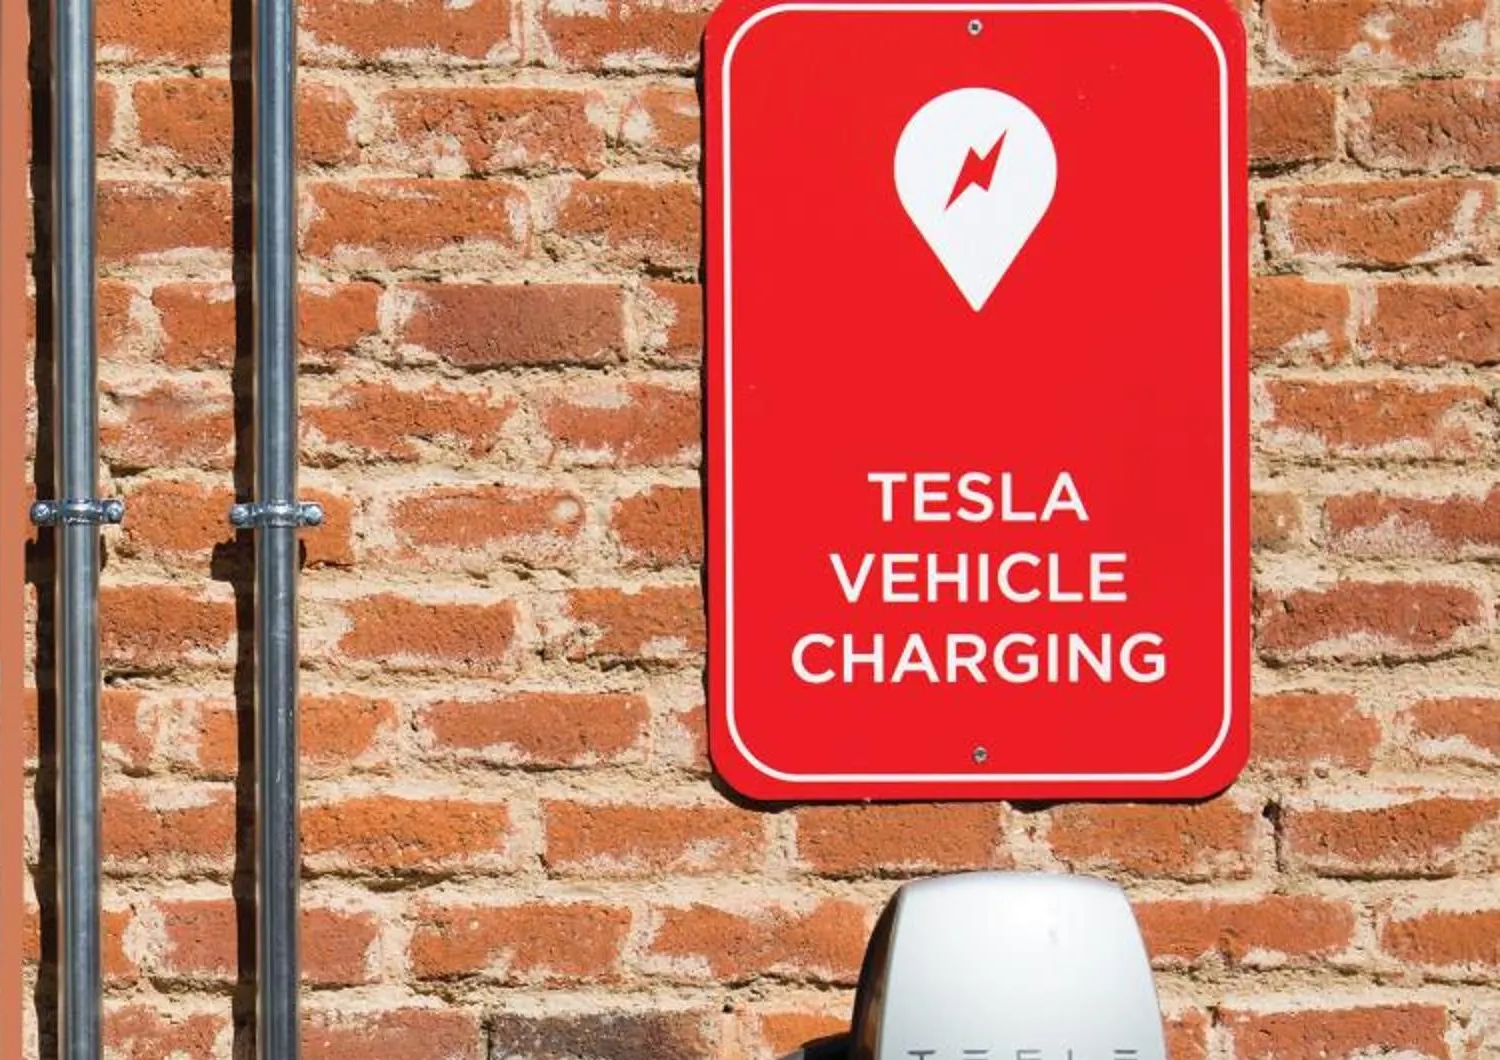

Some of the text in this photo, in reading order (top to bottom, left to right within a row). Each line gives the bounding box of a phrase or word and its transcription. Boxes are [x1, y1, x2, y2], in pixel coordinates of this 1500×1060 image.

[867, 471, 1089, 522] TESLA
[829, 552, 1127, 603] VEHICLE
[791, 633, 1166, 685] CHARGING
